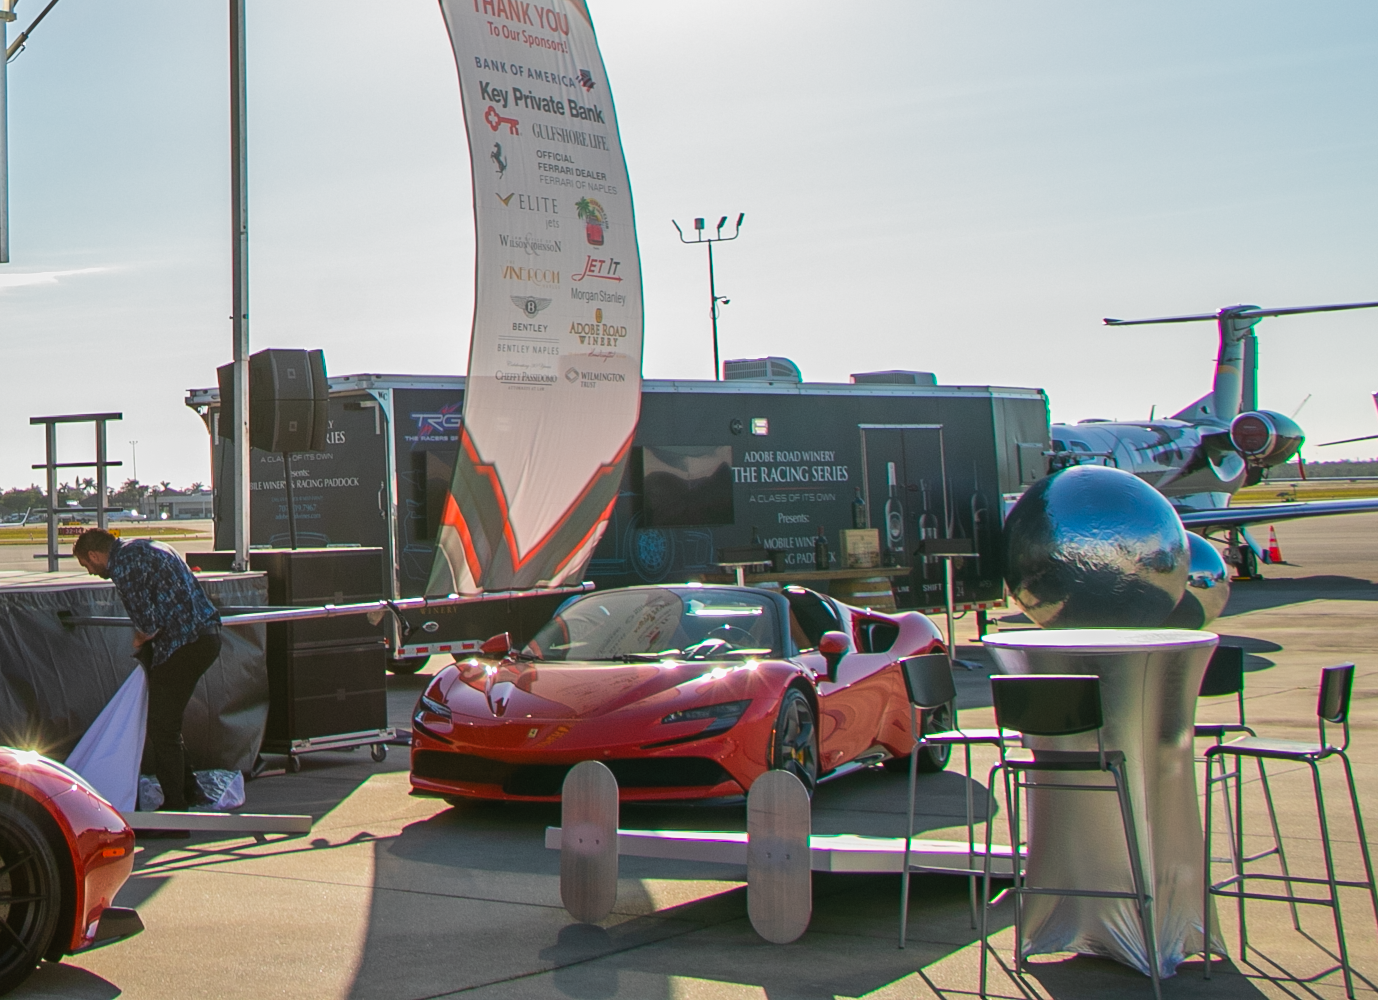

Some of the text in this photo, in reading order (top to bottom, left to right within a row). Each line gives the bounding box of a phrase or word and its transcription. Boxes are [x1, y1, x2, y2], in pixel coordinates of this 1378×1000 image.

[533, 5, 570, 36] YOU
[487, 21, 569, 54] To Our Sponsors!
[474, 56, 576, 89] BANK OF AMERICA
[479, 80, 605, 125] Key Private Bank
[532, 122, 589, 148] GULFSHORE
[536, 149, 575, 164] OFFICIAL
[537, 162, 607, 181] FERRARI DEALER
[539, 174, 618, 195] FERRARI OF NAPLES
[518, 193, 559, 215] ELITE
[545, 218, 560, 230] jets
[571, 288, 626, 306] Morgan Stanley
[512, 322, 548, 333] BENTLEY
[569, 321, 627, 337] ADOBE ROAD
[578, 335, 618, 347] WINERY
[497, 343, 559, 355] BENTLEY NAPLES
[580, 371, 625, 382] WILMINGTON
[411, 413, 462, 431] TRG
[303, 453, 316, 461] ITS
[744, 450, 836, 463] ADOBE ROAD WINERY
[731, 465, 849, 483] THE RACING SERIES
[296, 478, 323, 488] RACING
[324, 477, 359, 487] PADDOCK
[749, 493, 836, 503] A CLASS OF ITS OWN
[778, 512, 810, 524] Presents:
[763, 537, 794, 549] MOBILE
[922, 583, 942, 592] SHIFT
